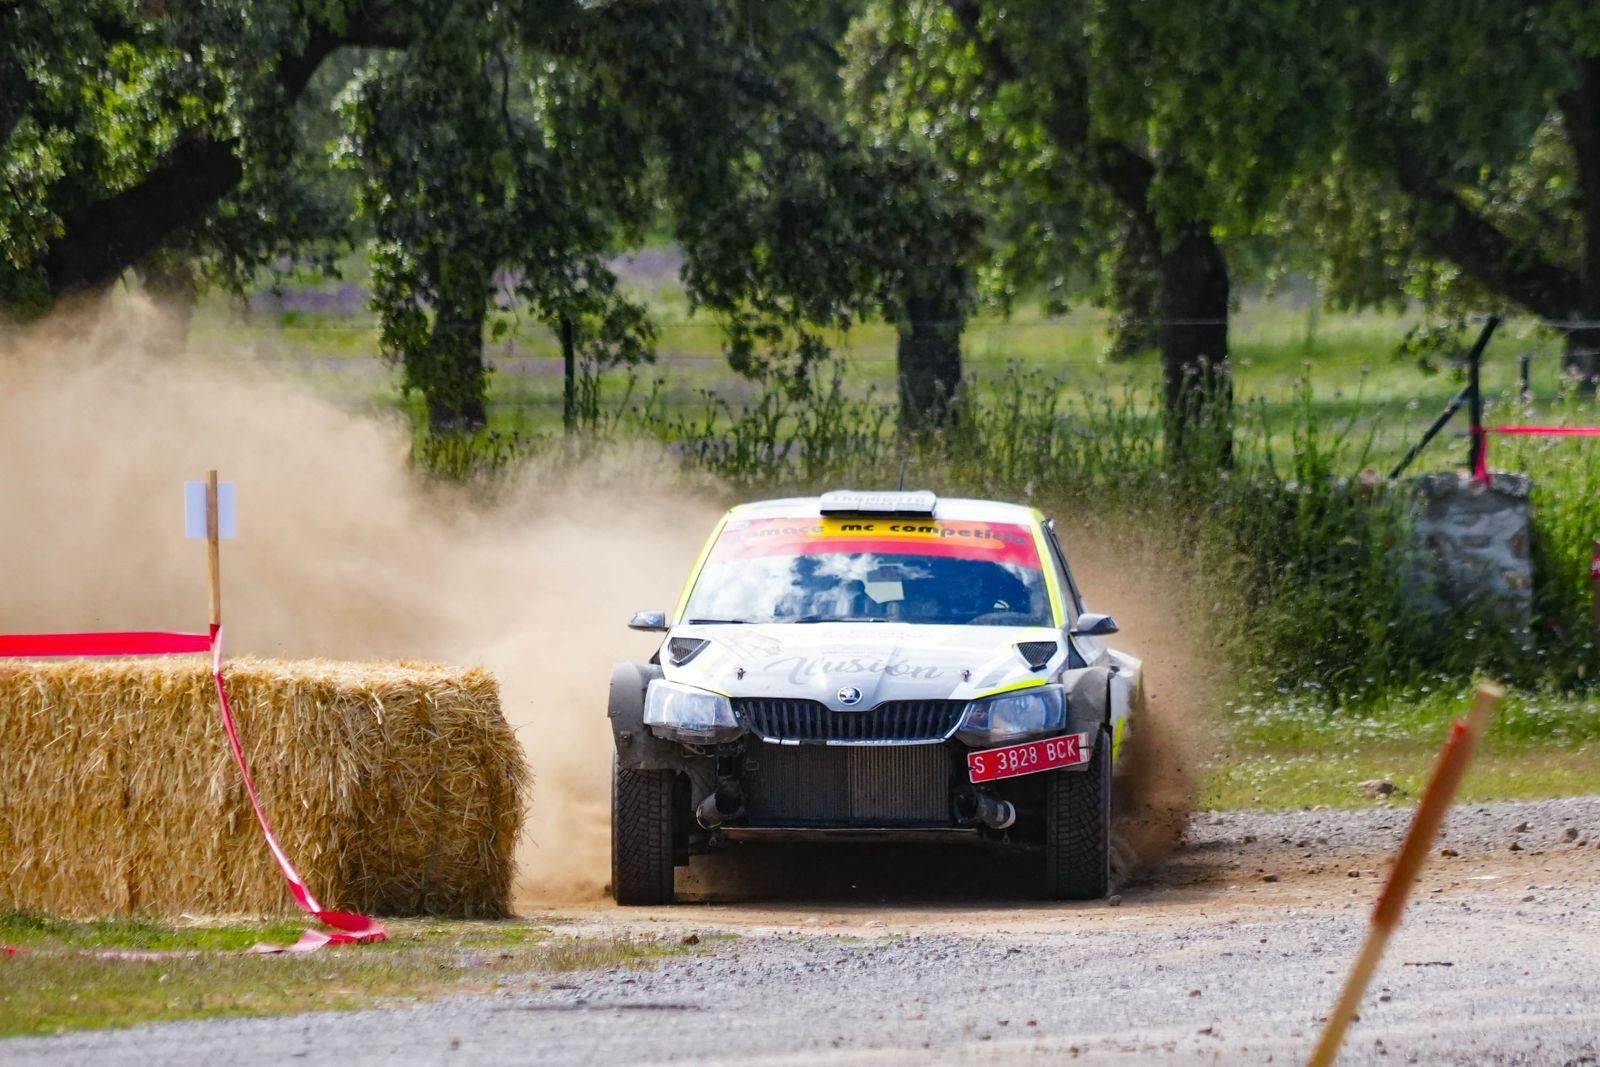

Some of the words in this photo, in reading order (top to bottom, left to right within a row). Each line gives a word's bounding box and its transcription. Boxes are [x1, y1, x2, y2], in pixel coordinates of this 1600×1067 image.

[841, 524, 875, 532] mc
[974, 756, 986, 774] S
[996, 746, 1038, 770] 3828
[1046, 739, 1076, 761] BCK
